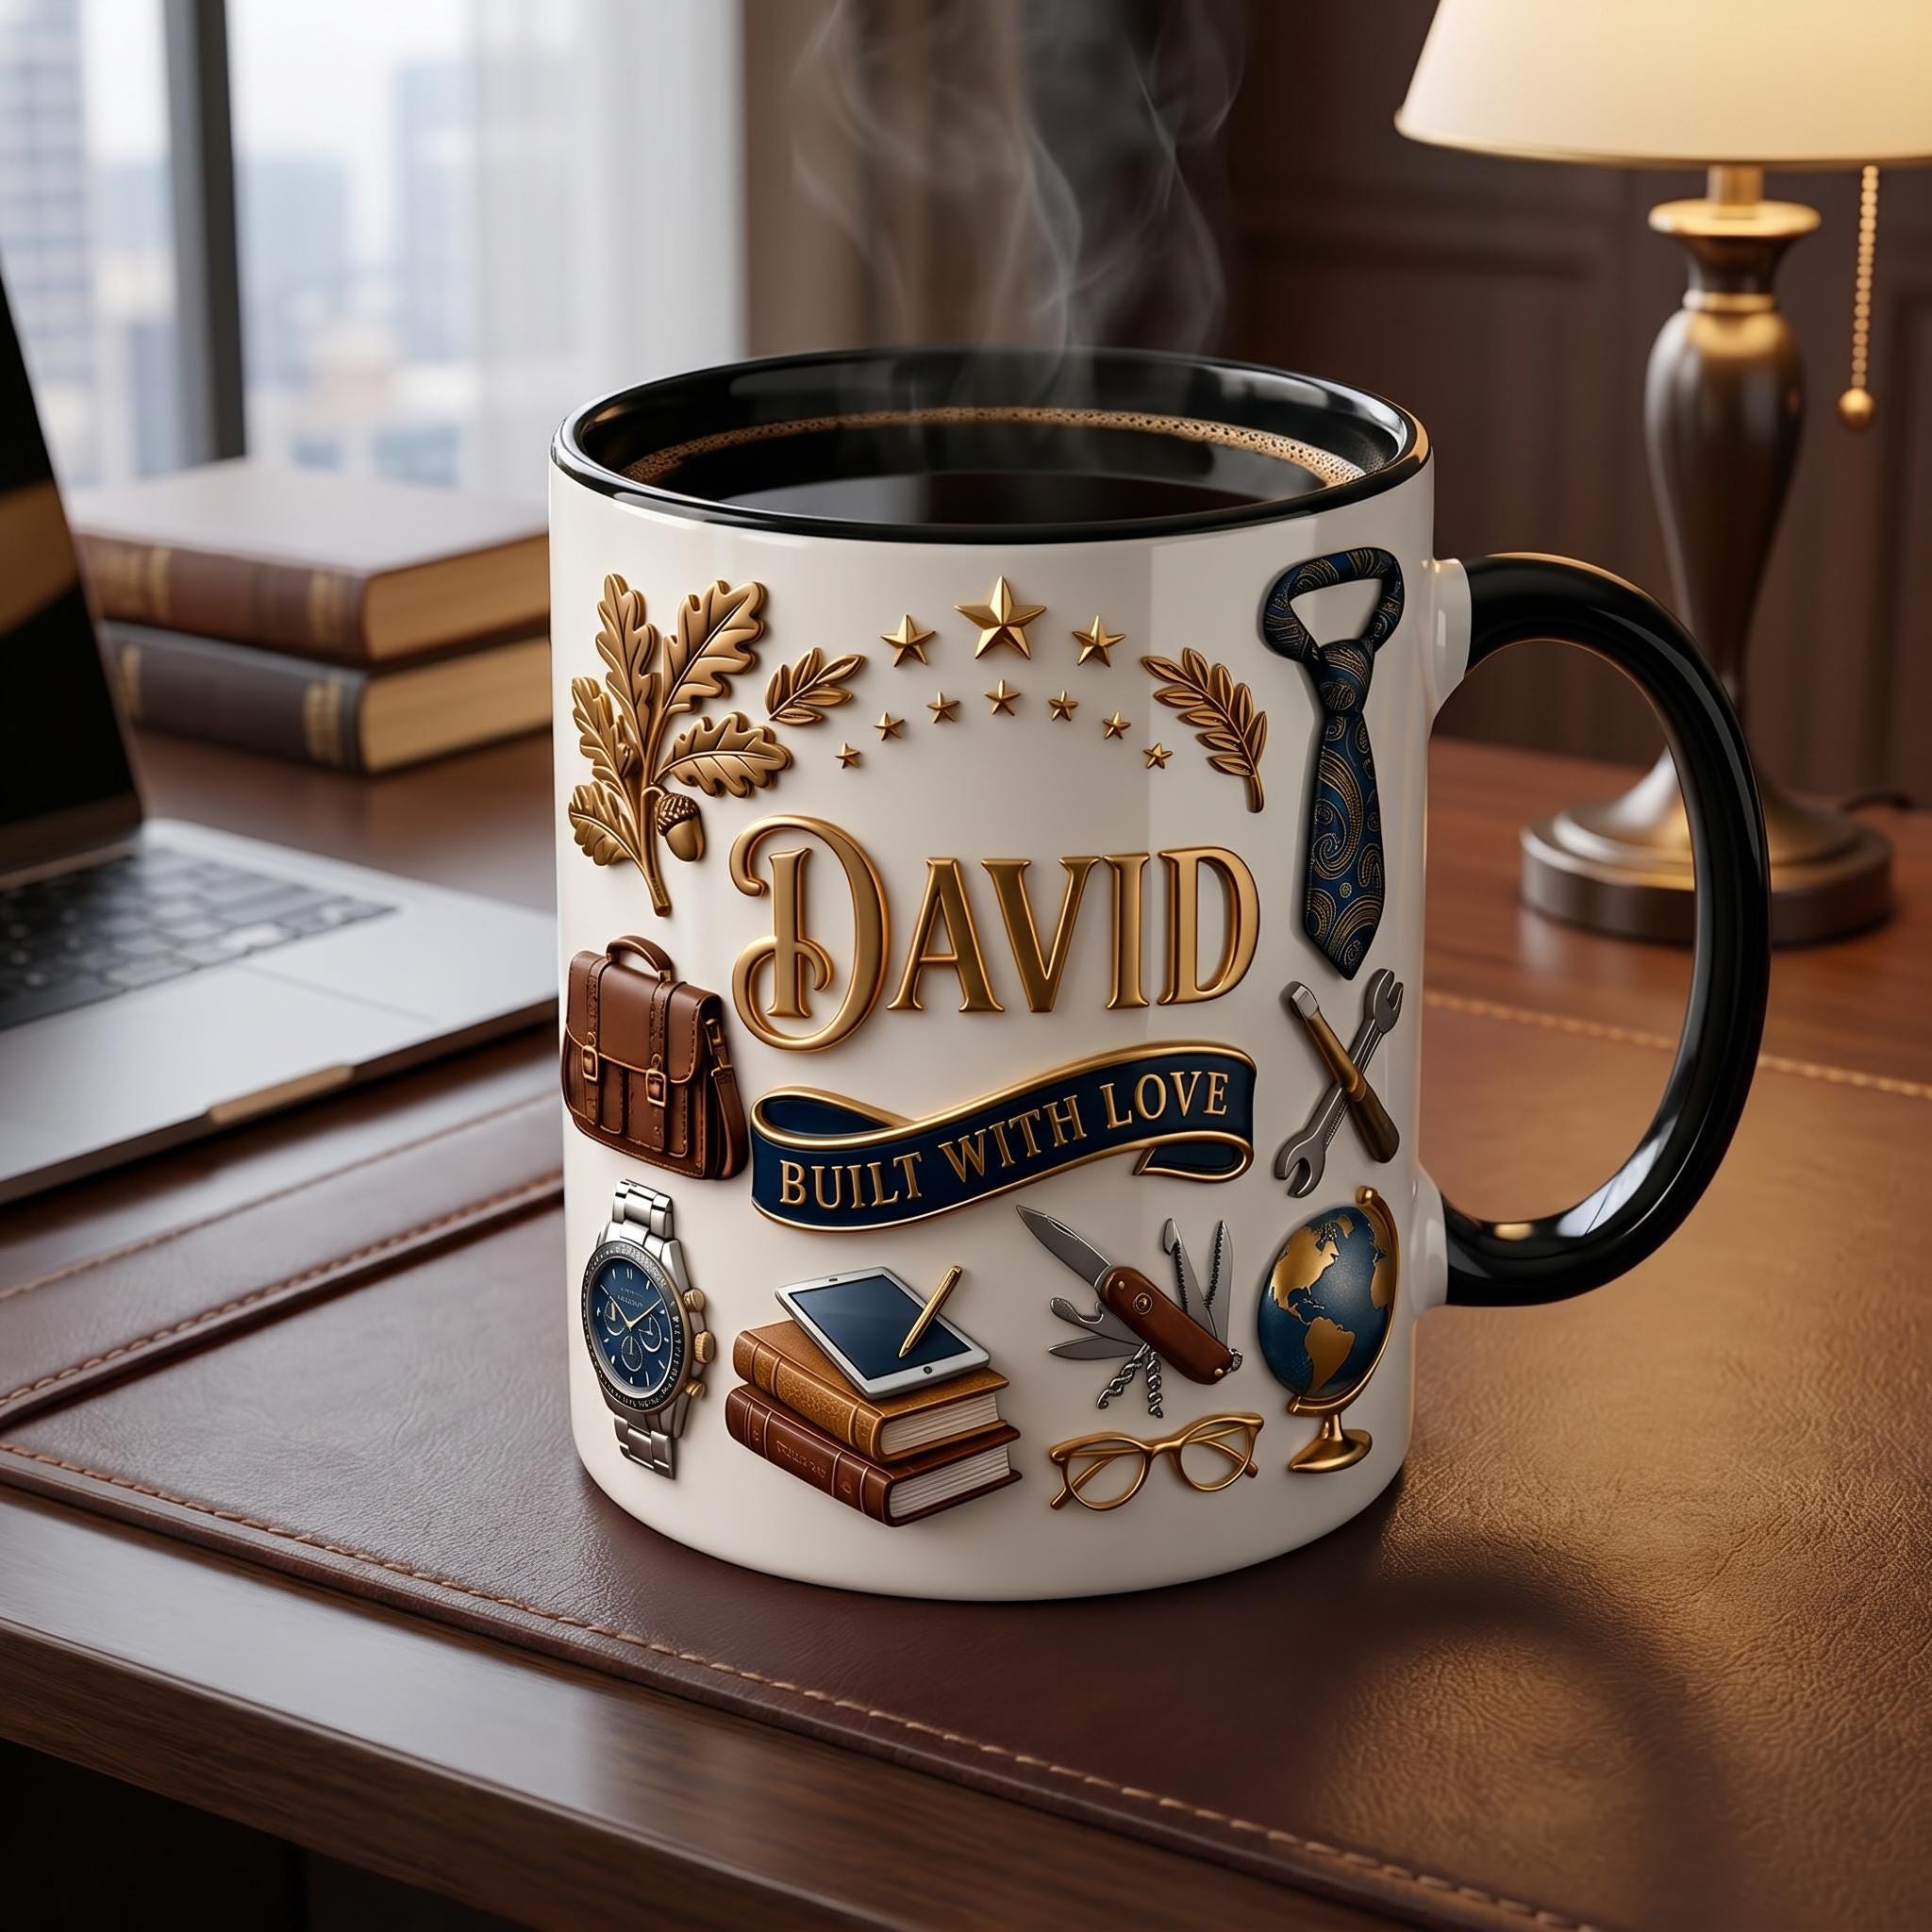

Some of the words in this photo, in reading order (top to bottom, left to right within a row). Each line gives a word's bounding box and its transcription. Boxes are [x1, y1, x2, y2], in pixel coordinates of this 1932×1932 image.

[729, 815, 1260, 1052] DAVID
[779, 1152, 923, 1208] BUILT
[939, 1094, 1087, 1183] WITH
[1099, 1070, 1229, 1129] LOVE
